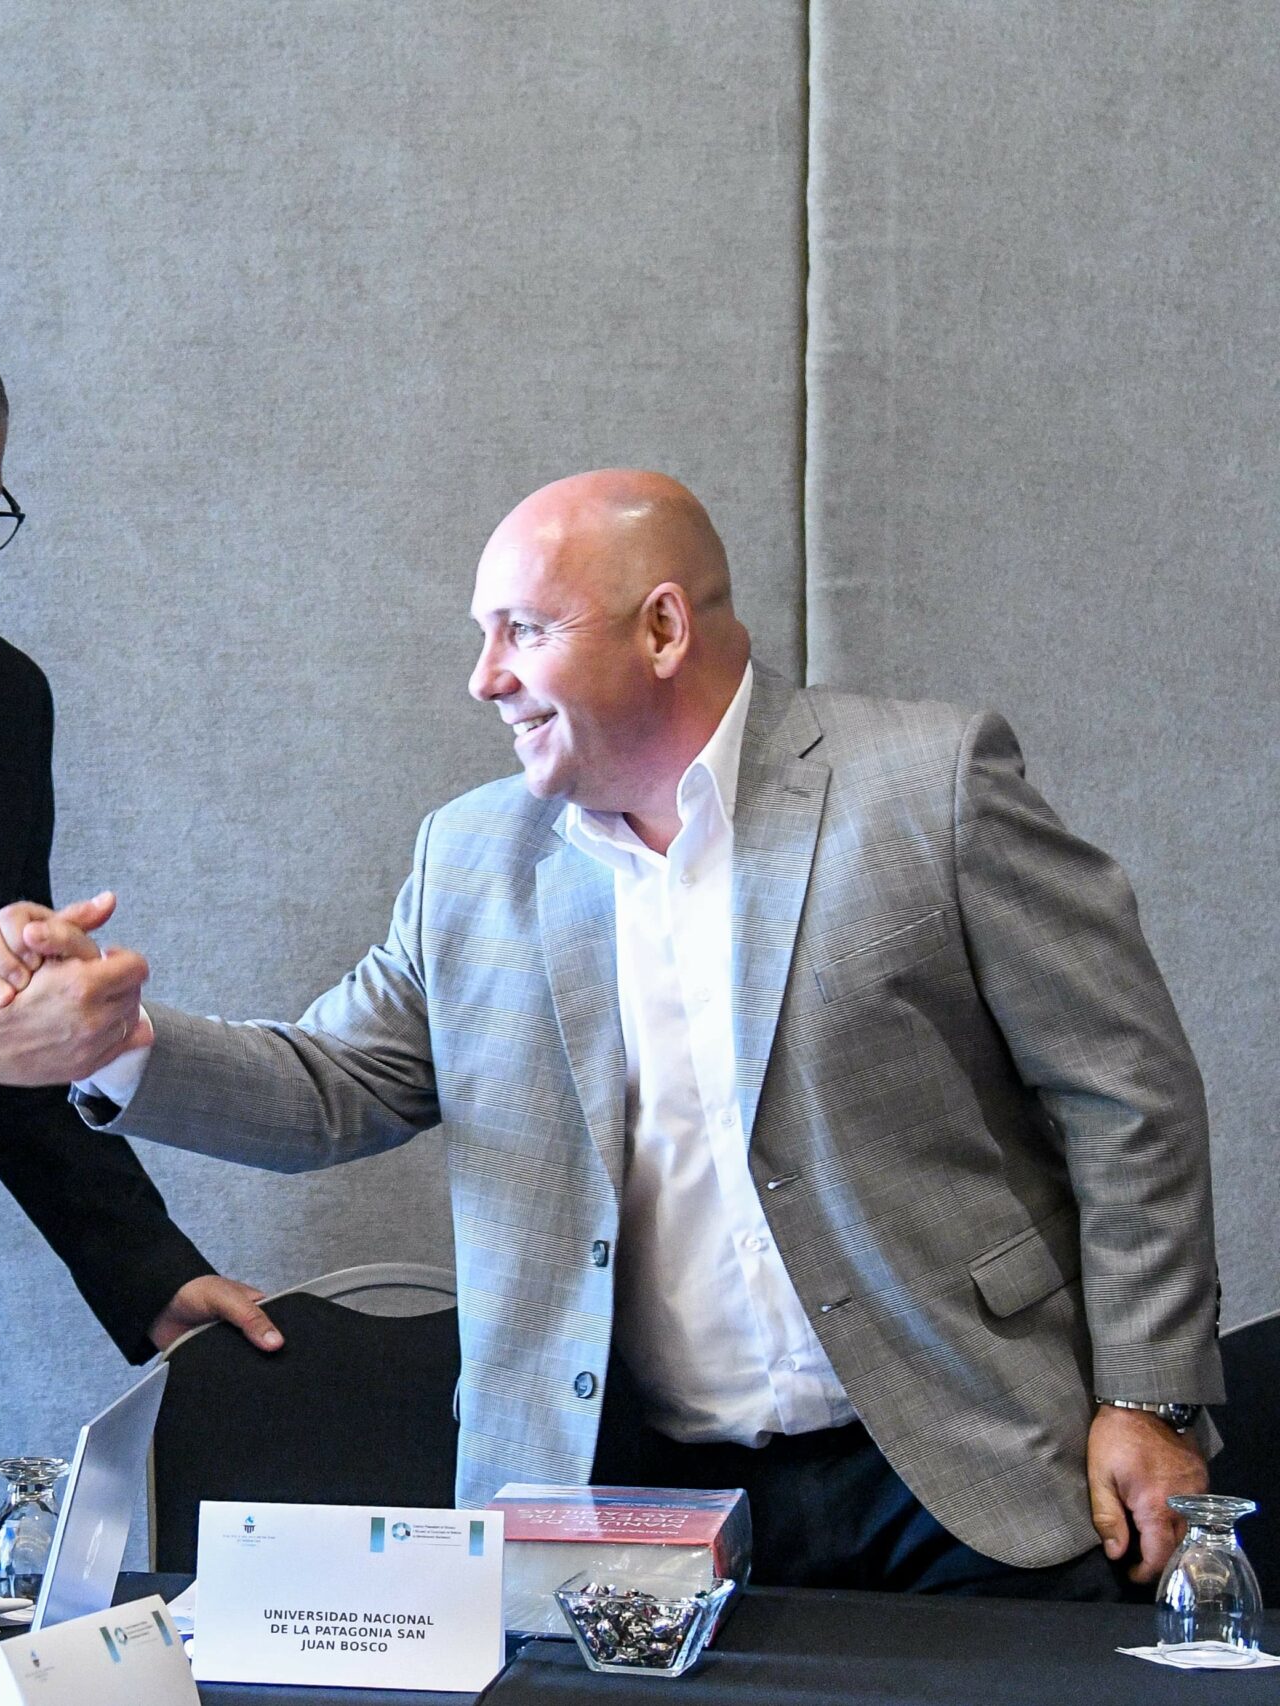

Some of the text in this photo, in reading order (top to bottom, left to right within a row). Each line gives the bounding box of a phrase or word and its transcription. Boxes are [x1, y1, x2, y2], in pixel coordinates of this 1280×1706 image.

[561, 1514, 686, 1524] DERECHO
[572, 1519, 683, 1529] MANUAL
[263, 1609, 435, 1626] UNIVERSIDAD NACIONAL
[270, 1623, 426, 1640] DE LA PATAGONIA SAN
[300, 1639, 388, 1653] JUAN BOSCO
